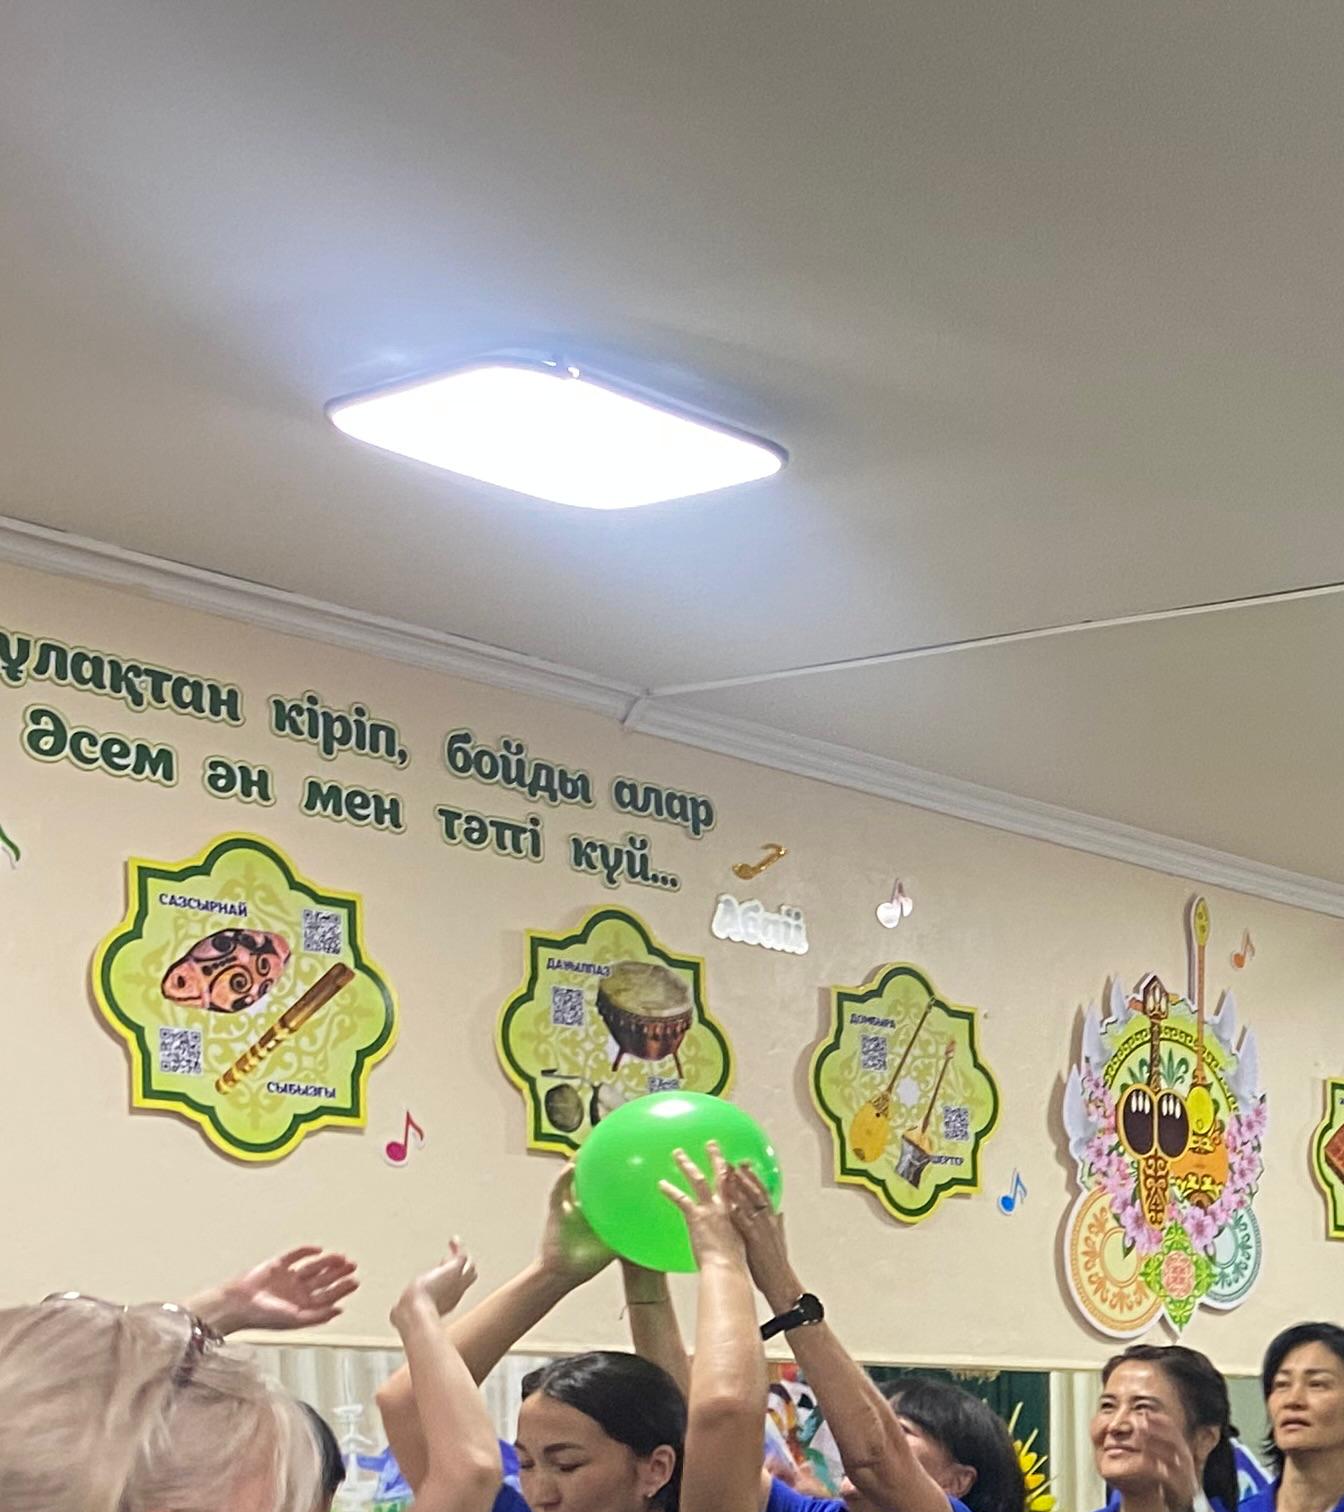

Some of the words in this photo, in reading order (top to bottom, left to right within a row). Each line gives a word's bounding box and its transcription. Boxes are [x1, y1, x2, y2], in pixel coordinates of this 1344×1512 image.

[0, 631, 243, 722] ұлақтан
[271, 692, 409, 765] кіріп,
[445, 732, 593, 805] бойды
[613, 777, 715, 836] алар
[26, 707, 175, 782] Әсем
[207, 759, 272, 801] ән
[304, 780, 402, 829] мен
[437, 810, 541, 859] тәтті
[159, 893, 248, 917] САЗСЫРНАЙ
